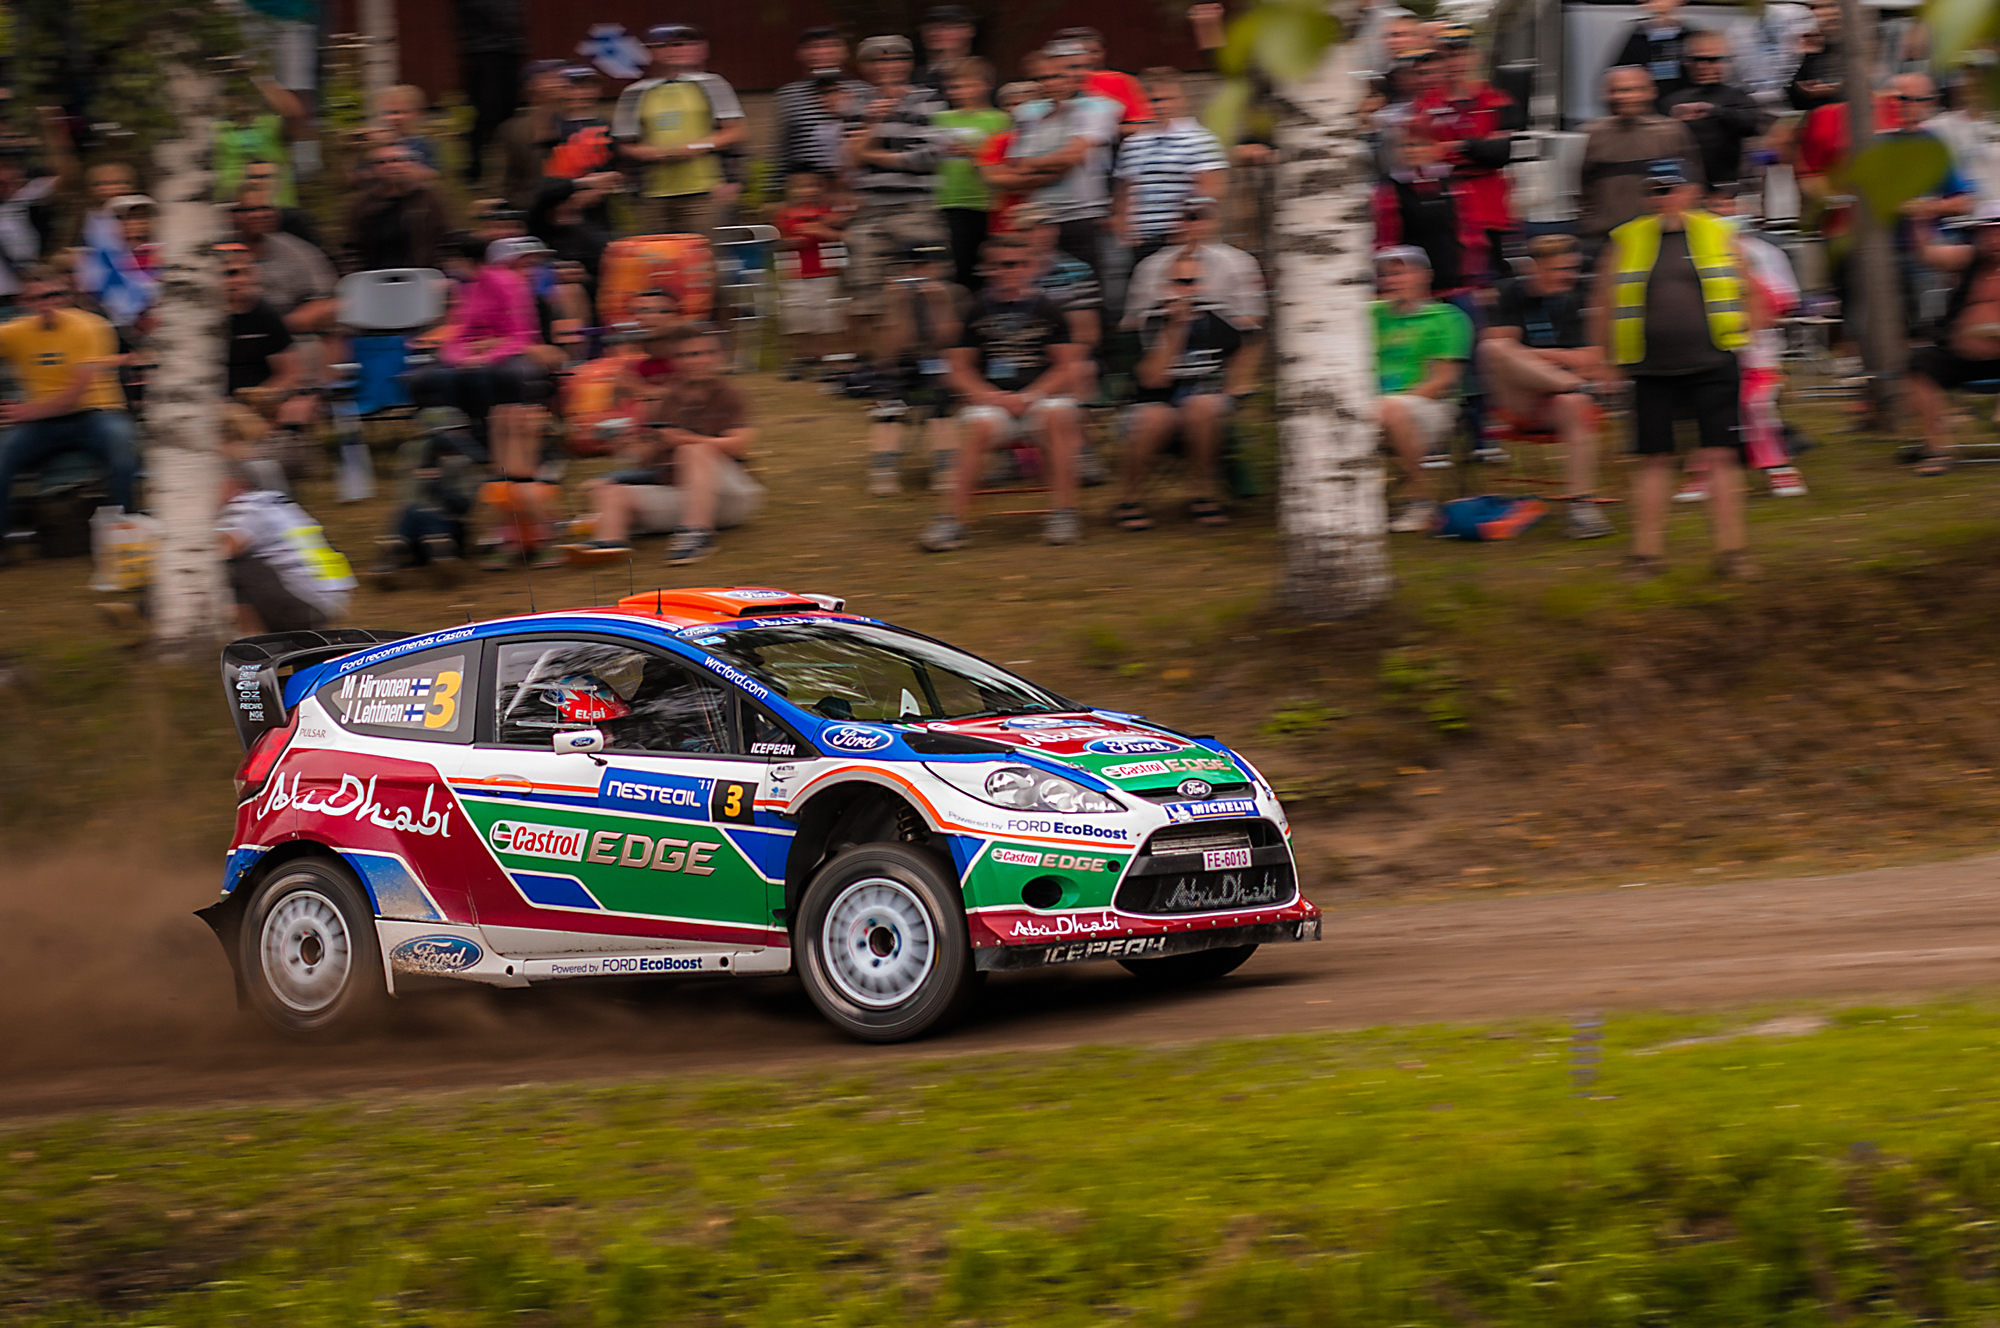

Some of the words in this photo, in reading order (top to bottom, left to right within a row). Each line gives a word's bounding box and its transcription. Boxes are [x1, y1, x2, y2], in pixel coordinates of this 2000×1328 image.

[339, 655, 367, 673] Ford
[365, 635, 435, 662] recommends
[435, 627, 476, 643] Castrol
[340, 674, 357, 699] M
[357, 674, 411, 699] Hirvonen
[704, 656, 769, 700] wrcford.com
[423, 670, 462, 729] 3
[340, 700, 353, 725] J
[352, 699, 405, 724] Lehtinen
[300, 727, 326, 738] PULSAR
[574, 737, 592, 747] Ford
[832, 727, 882, 749] Ford
[750, 742, 796, 756] ICEPEAK
[1102, 738, 1171, 754] Ford
[1119, 762, 1165, 776] Castrol
[1164, 758, 1232, 772] EDGE
[606, 780, 701, 808] NESTEOIL
[1186, 782, 1207, 795] Ford
[723, 783, 744, 818] 3
[1191, 800, 1255, 816] MICHELIN
[948, 810, 989, 829] Powered
[991, 822, 1003, 831] by
[1007, 819, 1051, 833] FORD
[1053, 822, 1128, 840] EcoBoost
[512, 825, 581, 857] Castrol
[586, 830, 722, 876] EDGE
[1003, 851, 1039, 864] Castrol
[1041, 853, 1108, 873] EDGE
[1206, 849, 1248, 868] FE-6013
[413, 941, 467, 967] Ford
[1043, 936, 1167, 964] ICEPEAK
[551, 964, 587, 974] Powered
[588, 963, 599, 974] by
[602, 958, 638, 972] FORD
[639, 956, 703, 971] EcoBoost
